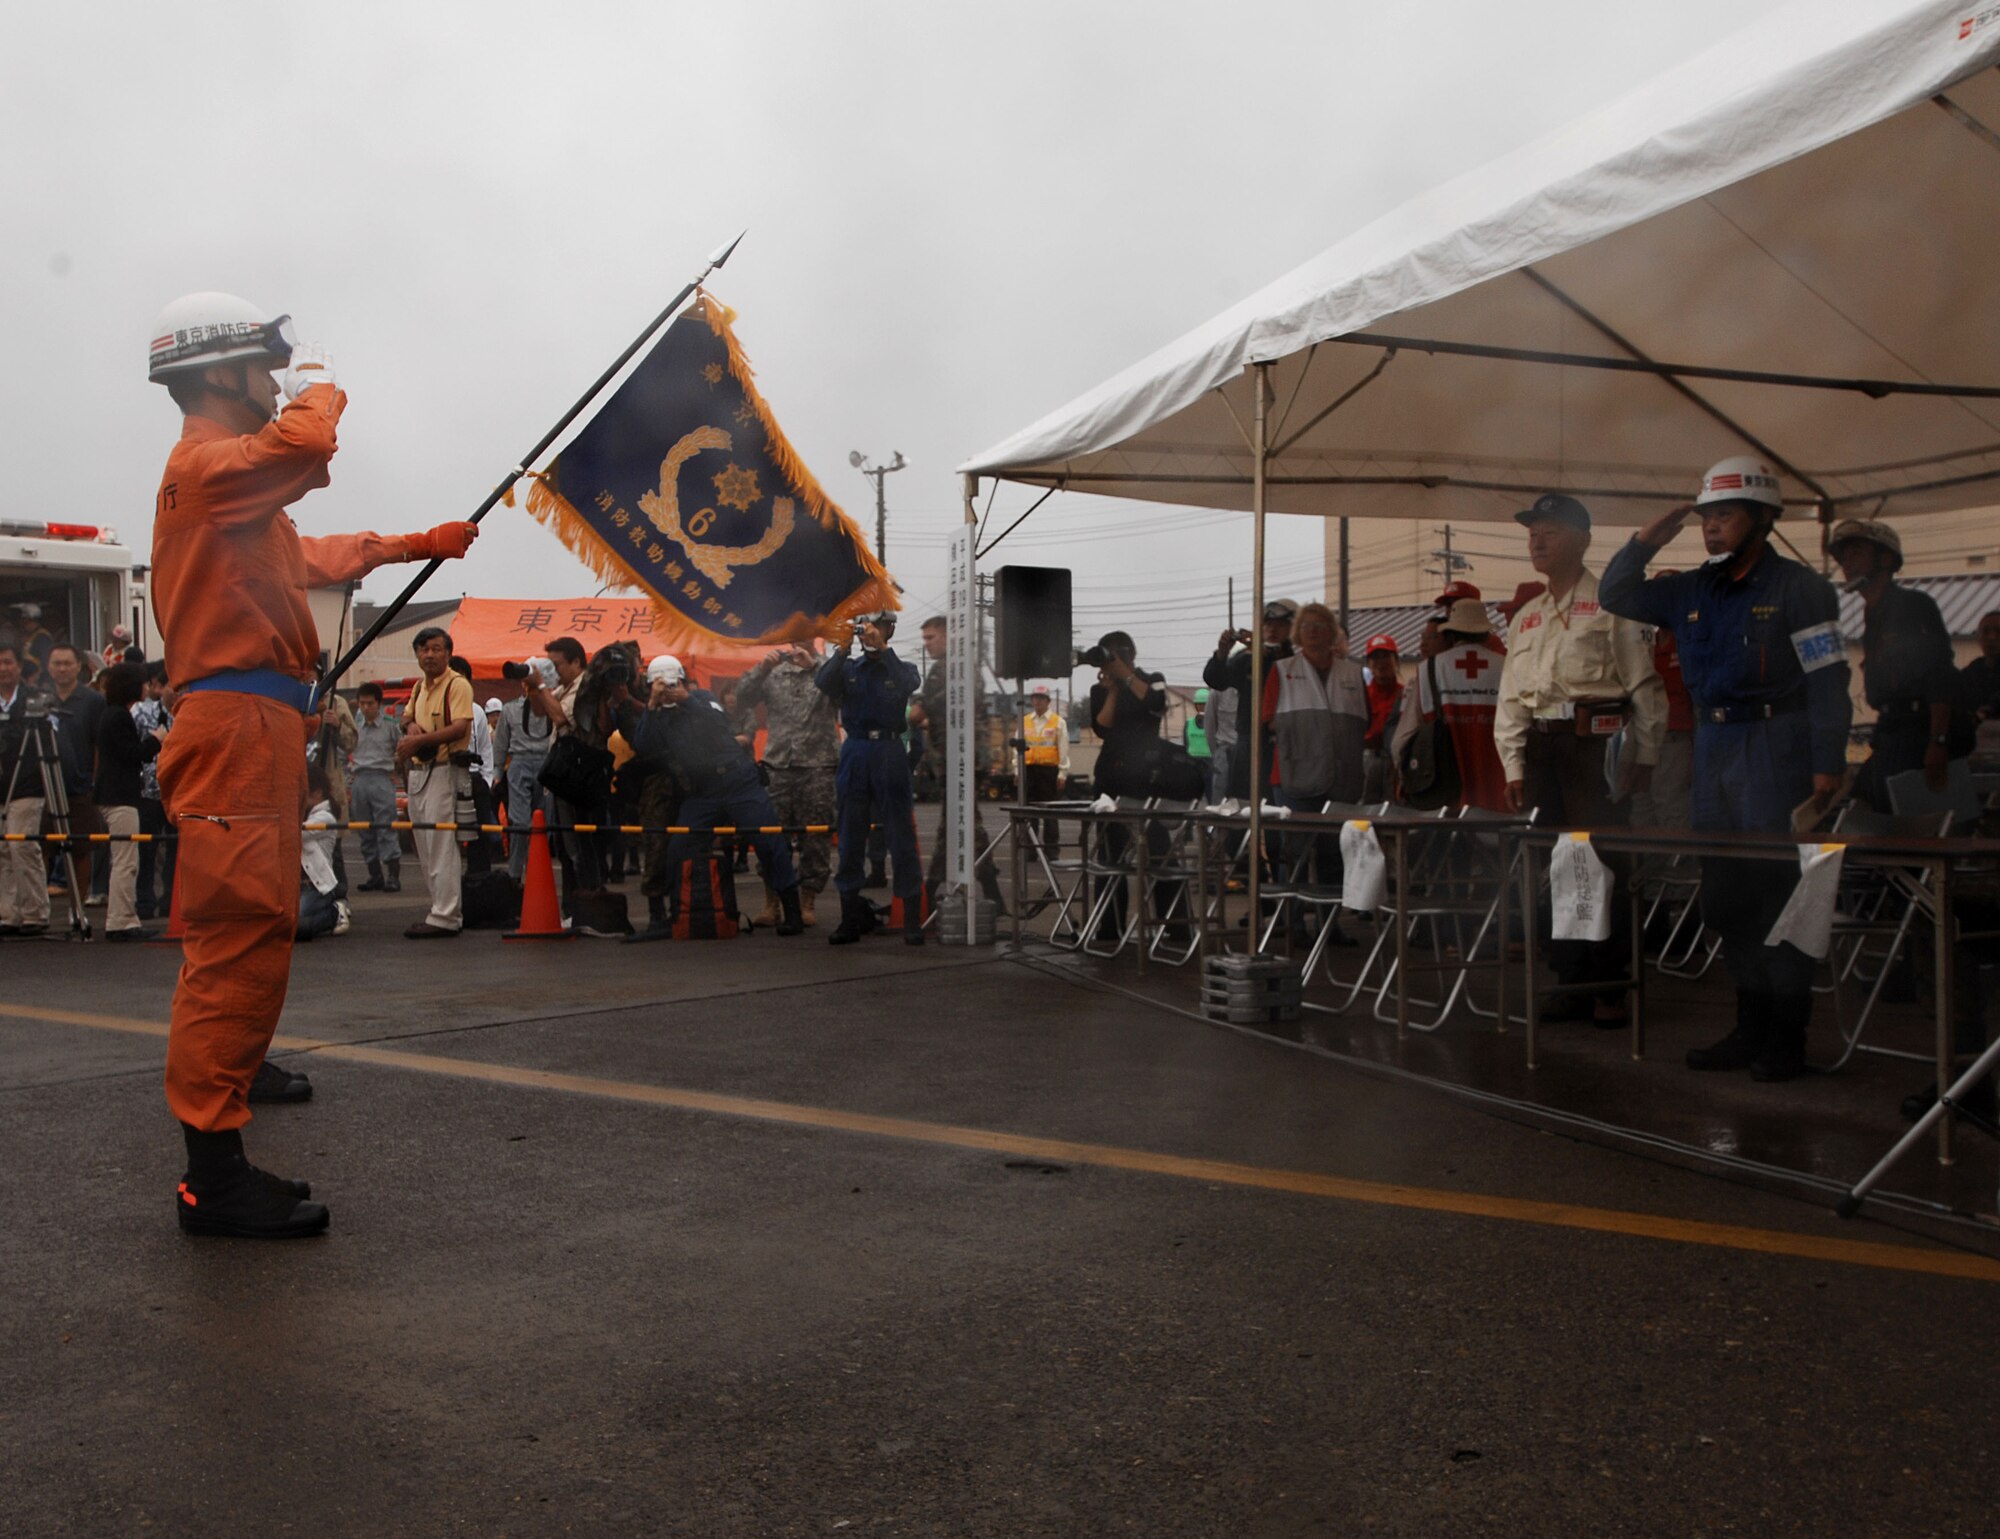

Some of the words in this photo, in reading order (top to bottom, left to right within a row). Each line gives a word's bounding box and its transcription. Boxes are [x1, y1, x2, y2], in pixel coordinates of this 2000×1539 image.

[174, 322, 251, 349] 東京消防庁
[687, 507, 718, 537] 6
